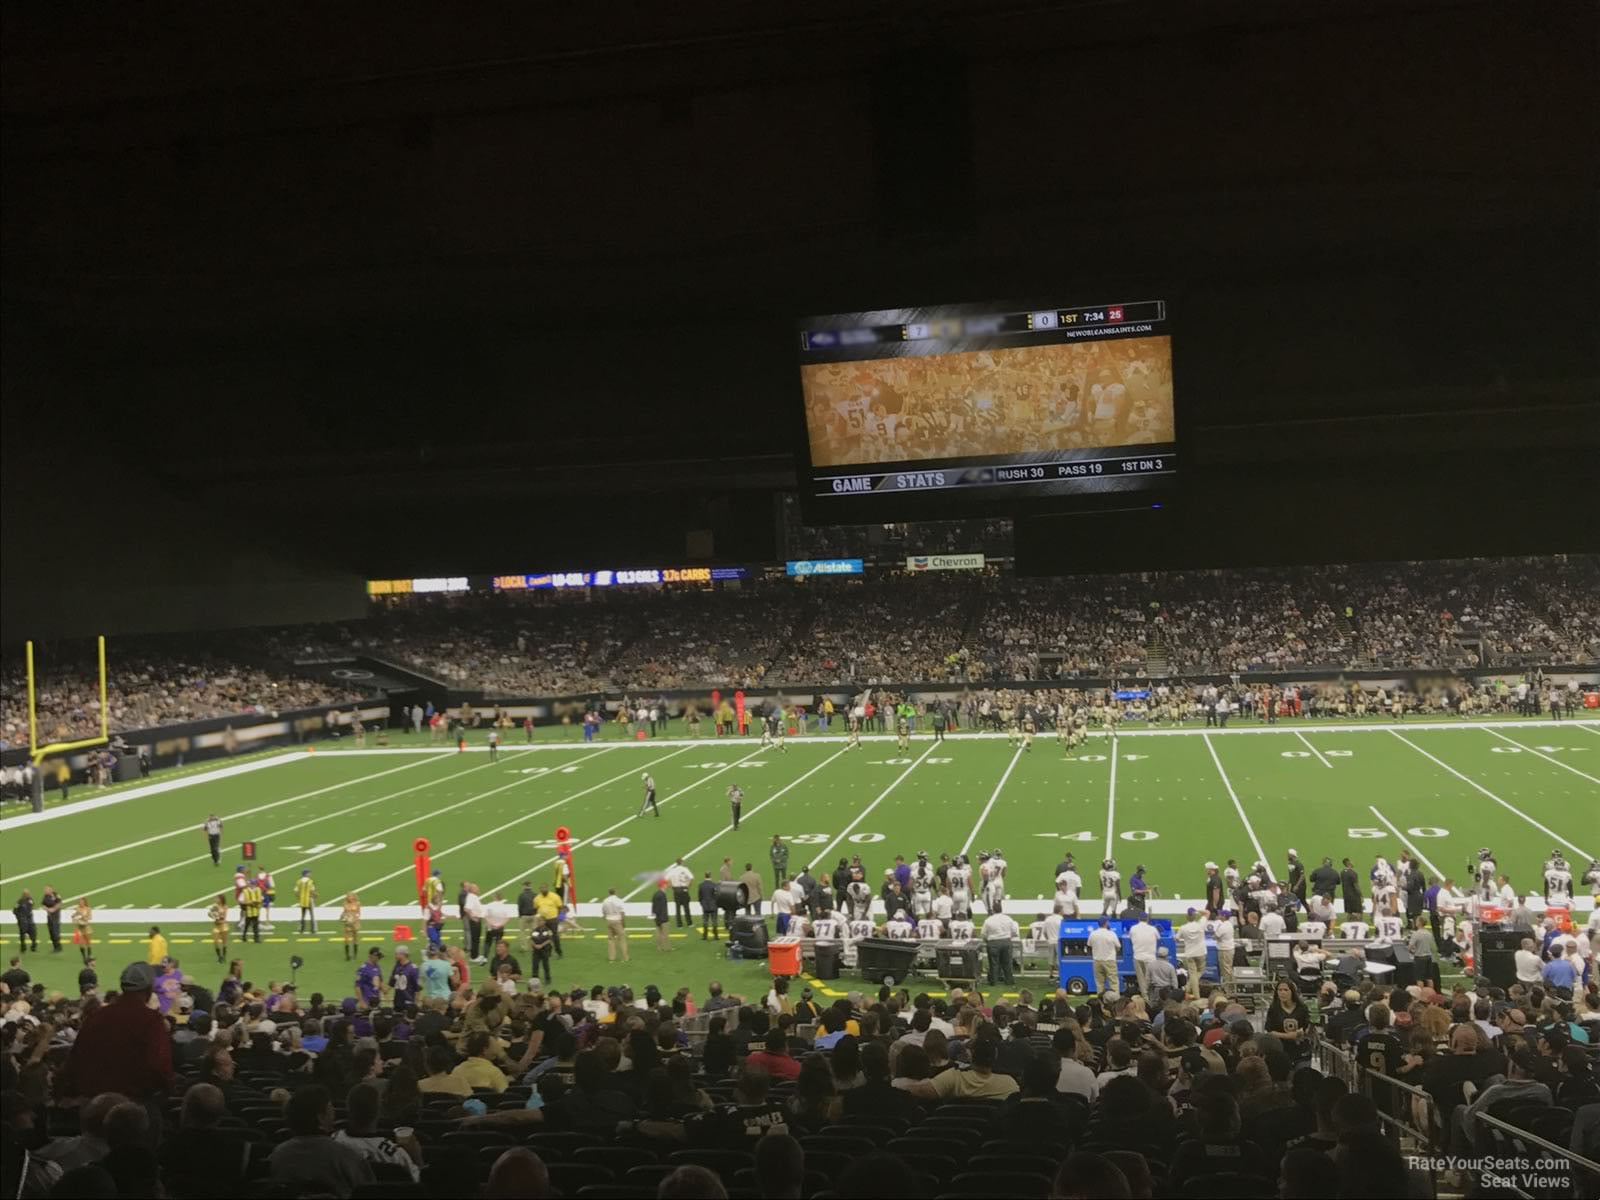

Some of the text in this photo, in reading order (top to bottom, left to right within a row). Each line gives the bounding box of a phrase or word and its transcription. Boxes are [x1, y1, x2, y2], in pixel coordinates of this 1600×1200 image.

[1042, 315, 1048, 326] 0
[1060, 310, 1121, 324] 1ST 7:34 25
[1058, 463, 1103, 476] PASS 19
[1121, 460, 1163, 472] 1ST DN 3
[998, 467, 1044, 480] RUSH 30
[832, 473, 945, 492] GAME STATS
[813, 562, 853, 574] Allstate
[932, 556, 978, 567] Chevron
[680, 568, 711, 581] CARBS
[791, 833, 886, 844] 30
[1060, 830, 1160, 842] 40
[1347, 827, 1450, 838] 50
[952, 878, 964, 889] 91
[1550, 878, 1564, 892] 51
[816, 923, 831, 937] 77
[852, 924, 869, 938] 68
[922, 925, 934, 938] 71
[954, 928, 968, 940] 76
[1350, 926, 1360, 940] 7
[1383, 922, 1396, 936] 15
[1370, 1052, 1386, 1075] 9
